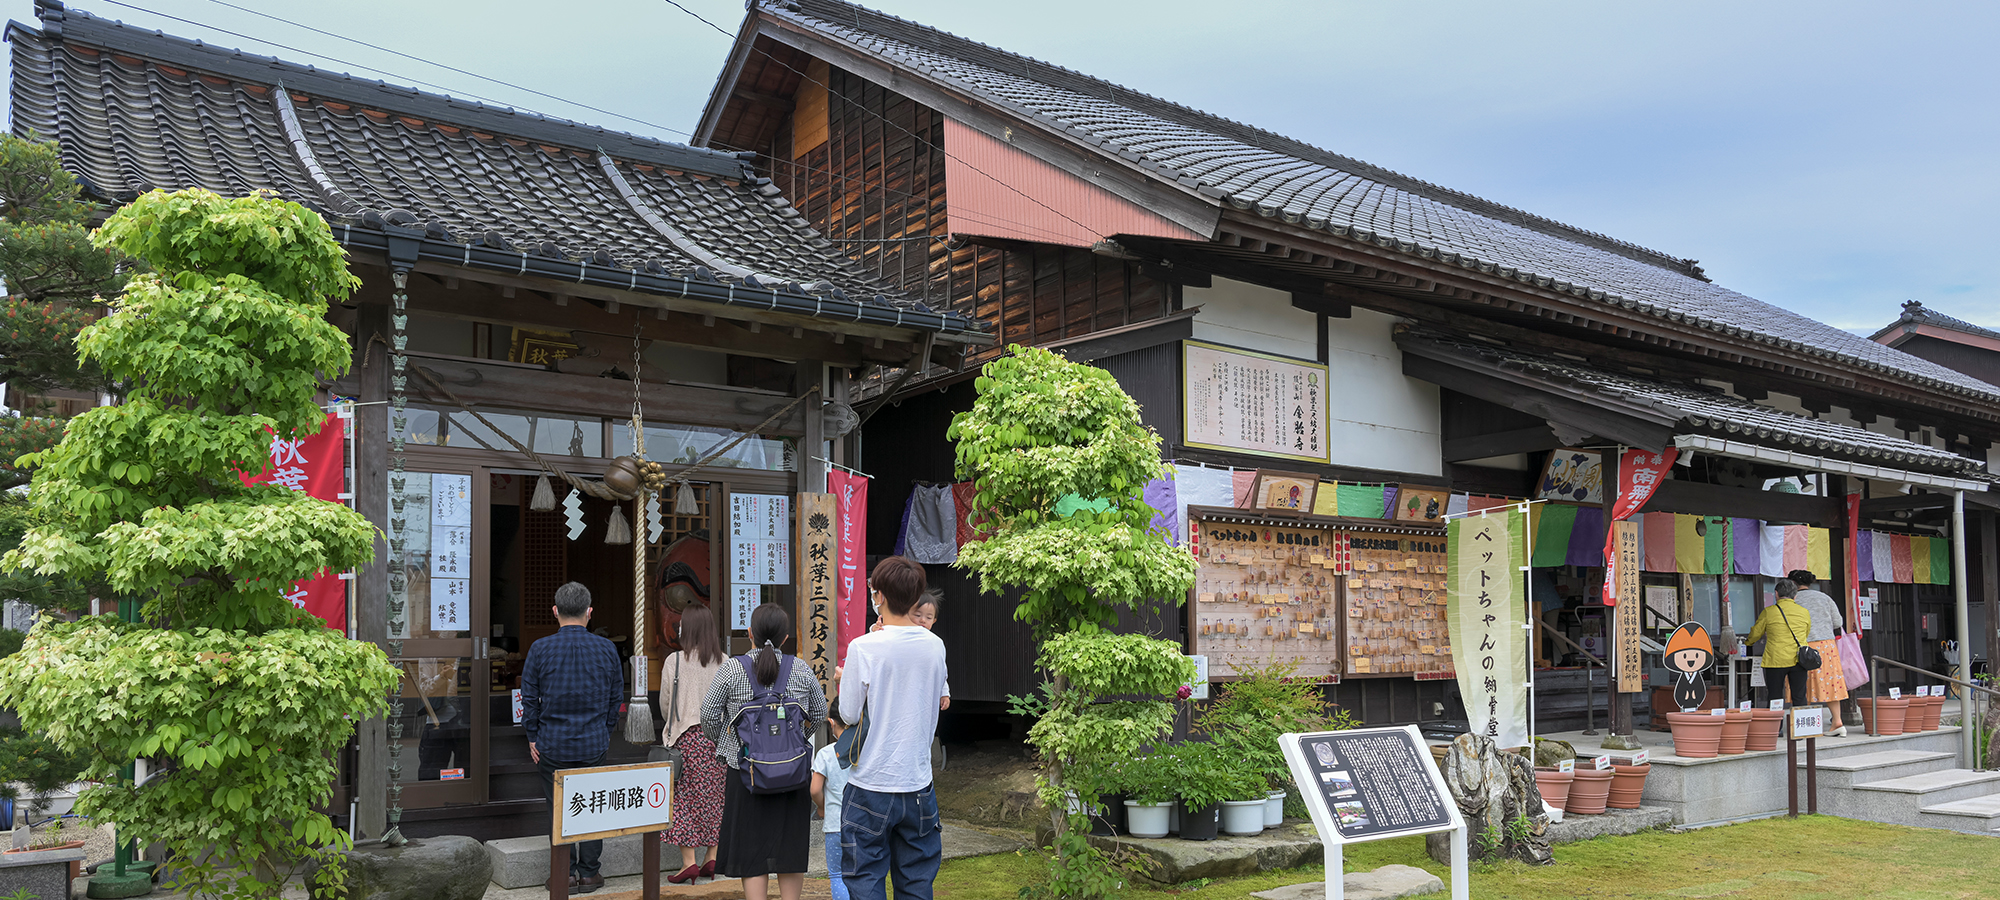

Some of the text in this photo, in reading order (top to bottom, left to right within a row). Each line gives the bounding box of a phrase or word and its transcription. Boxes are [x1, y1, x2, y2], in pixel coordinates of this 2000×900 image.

[1474, 527, 1499, 737] ペットちゃんの納骨堂
